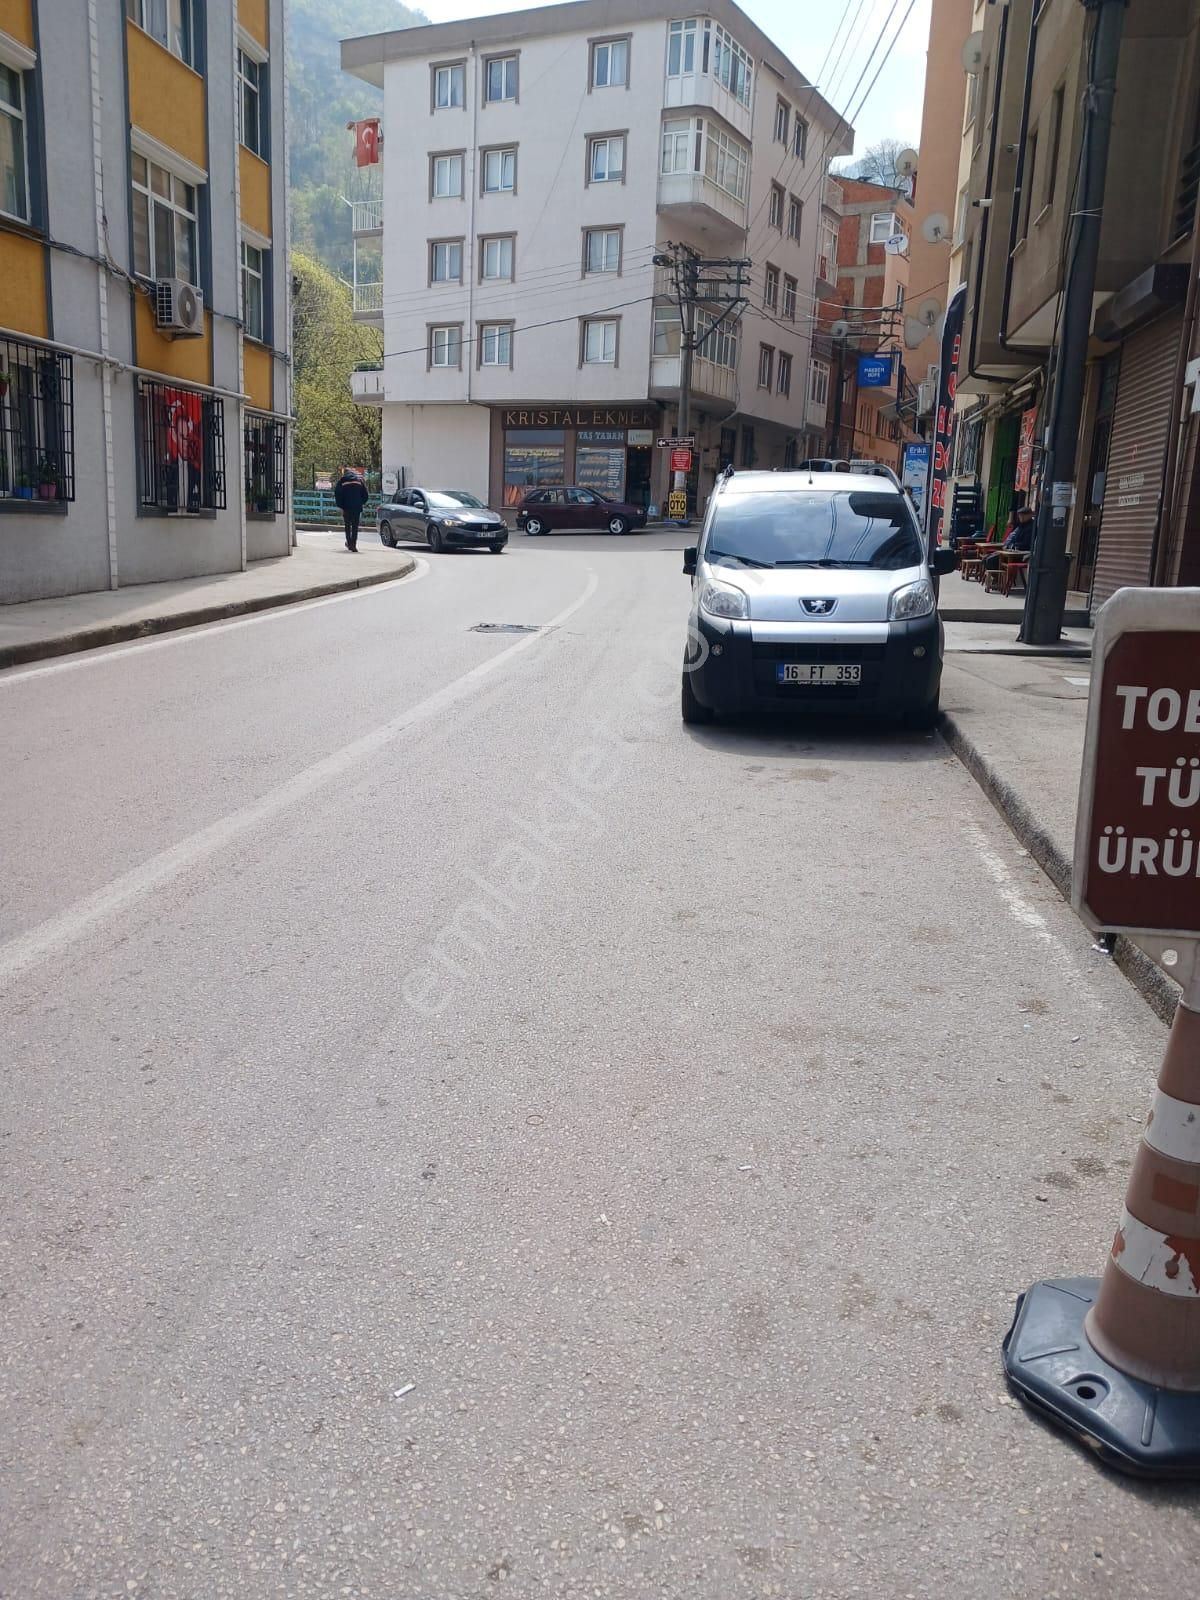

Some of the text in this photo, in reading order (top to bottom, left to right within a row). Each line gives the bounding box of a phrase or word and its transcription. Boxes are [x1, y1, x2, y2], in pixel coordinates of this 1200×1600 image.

[506, 409, 655, 425] KRISTAL EKMEK
[670, 499, 686, 510] OTO
[785, 666, 860, 680] 16 FT 353
[1098, 825, 1200, 878] ÜRÜ
